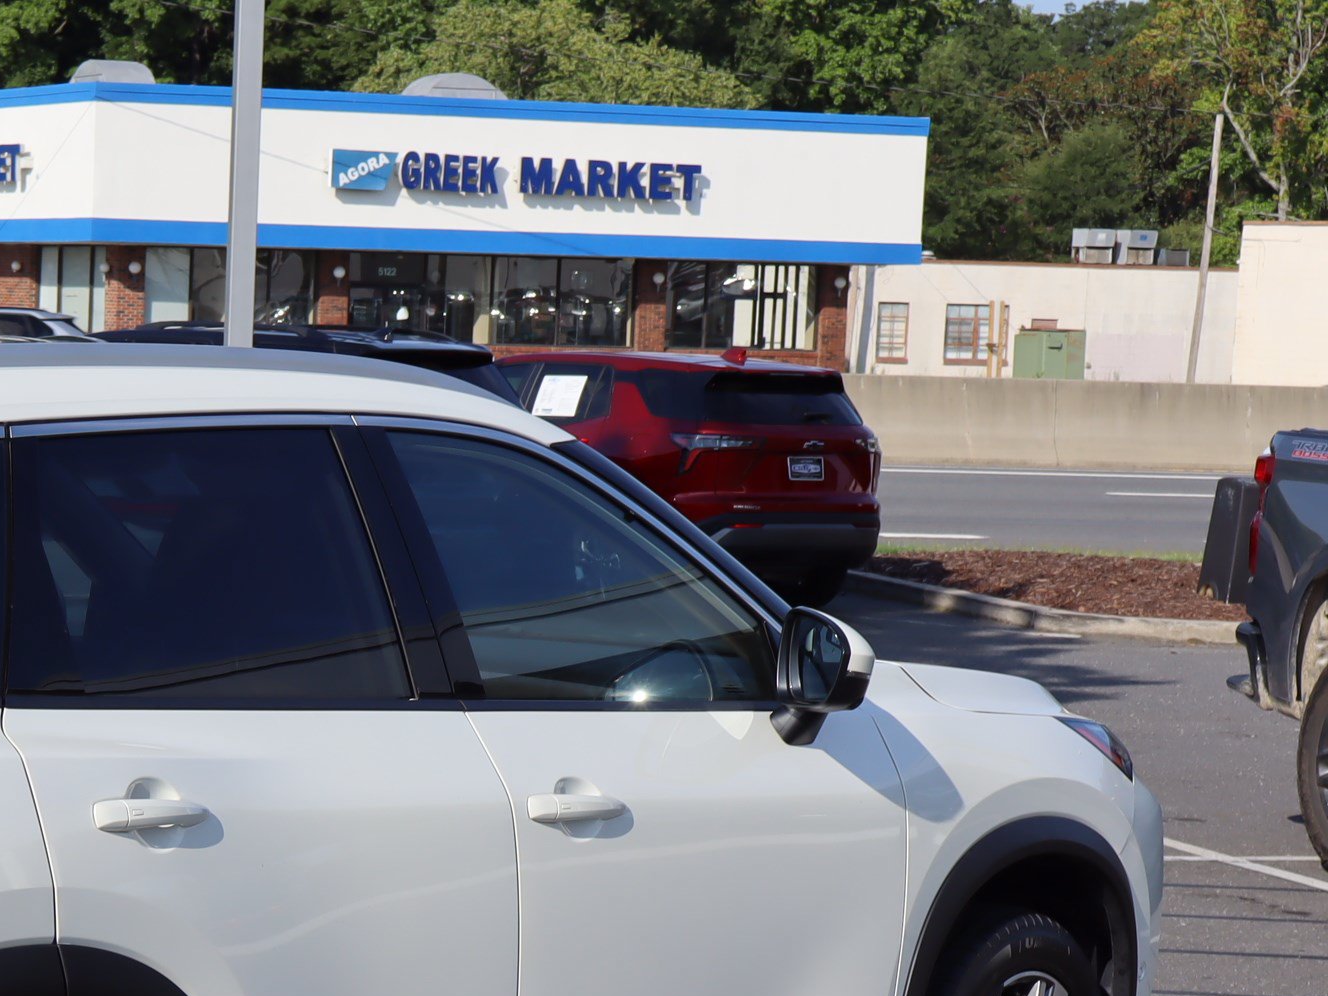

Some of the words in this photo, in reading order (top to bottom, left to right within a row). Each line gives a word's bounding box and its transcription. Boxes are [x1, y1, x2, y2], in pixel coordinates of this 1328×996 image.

[338, 153, 390, 187] AGORA
[401, 151, 500, 194] GREEK
[519, 156, 702, 201] MARKET
[378, 266, 397, 277] 5122
[1292, 439, 1328, 452] TRA
